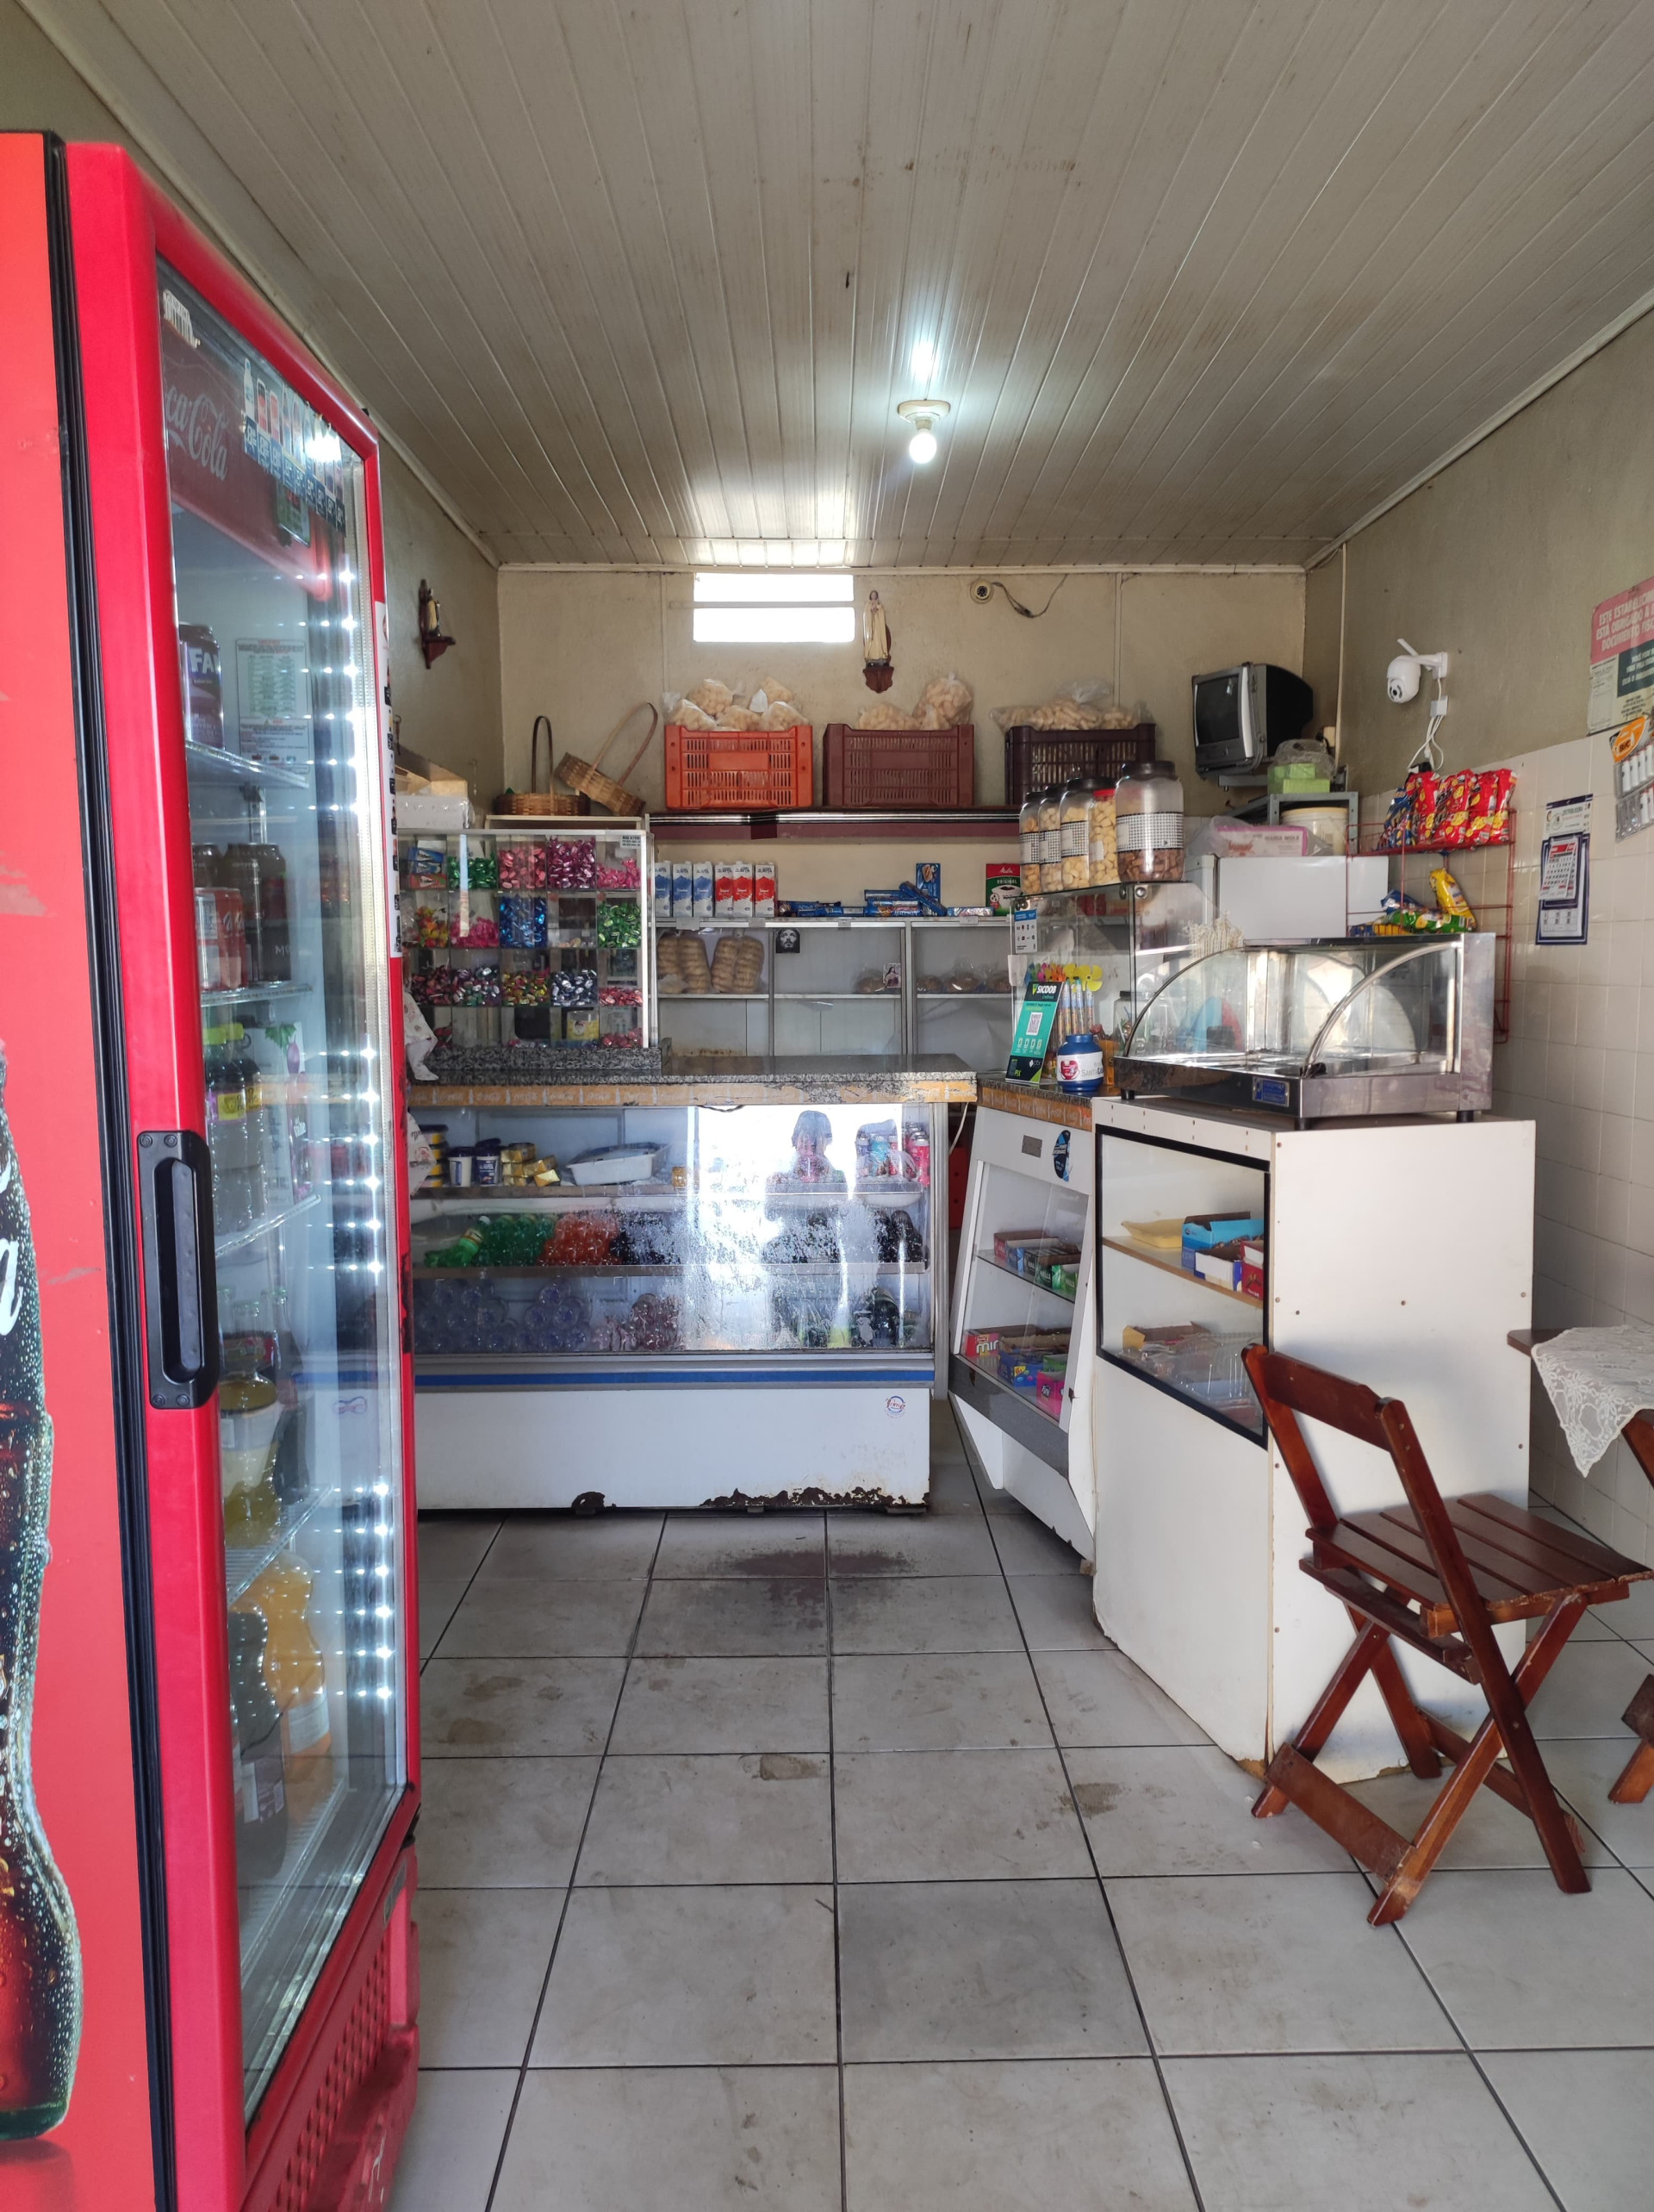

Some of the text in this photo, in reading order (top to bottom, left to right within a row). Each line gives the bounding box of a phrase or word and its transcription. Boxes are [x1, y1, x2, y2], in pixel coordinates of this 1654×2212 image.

[1599, 609, 1614, 626] ESTE
[1611, 608, 1644, 633] OBRIGADO
[1601, 624, 1640, 651] DOCUMENTO
[1619, 740, 1631, 752] BIC
[1036, 984, 1058, 994] SICOOB
[1040, 1270, 1051, 1280] HALLS
